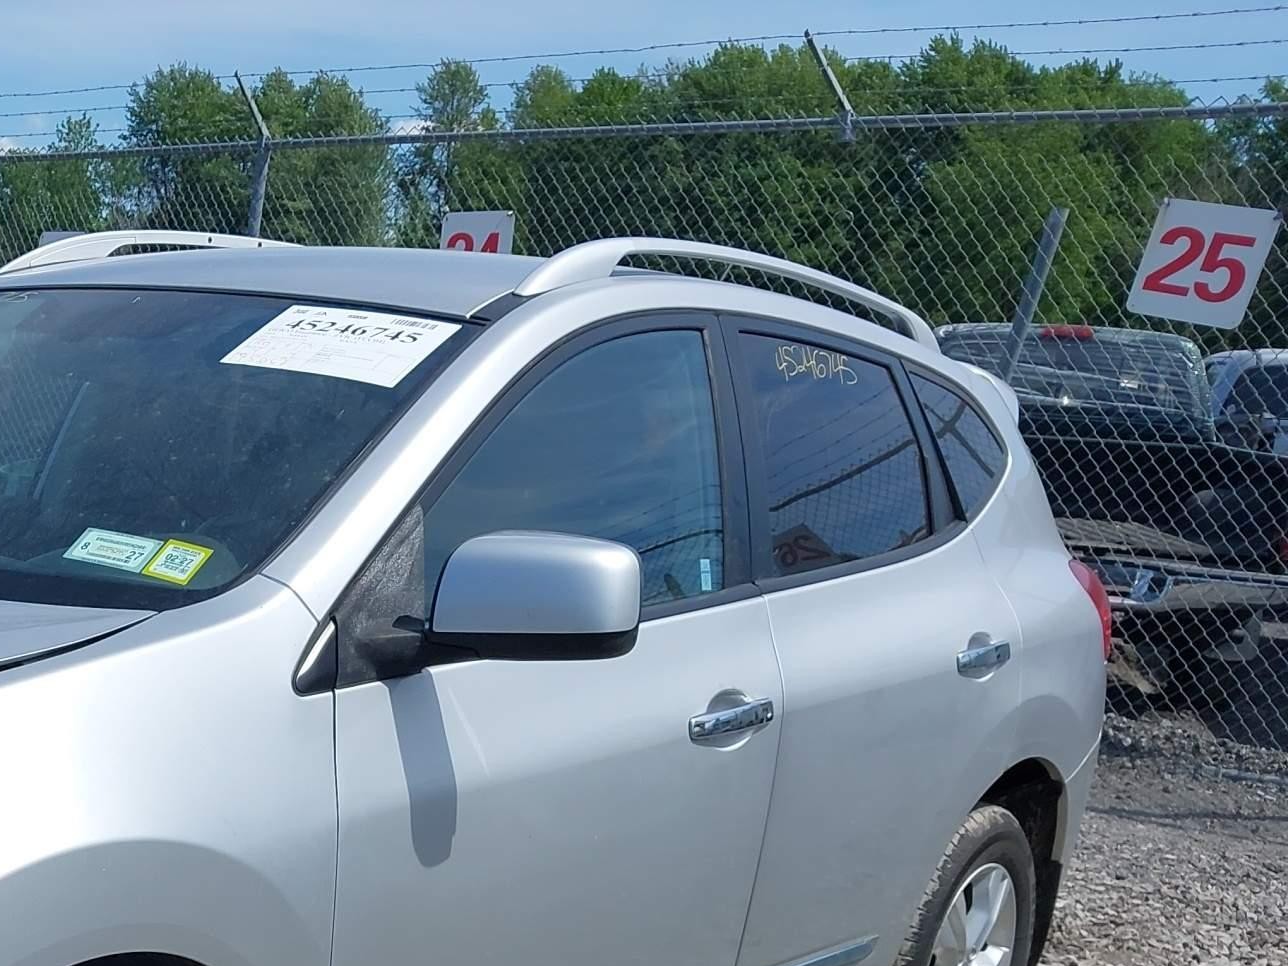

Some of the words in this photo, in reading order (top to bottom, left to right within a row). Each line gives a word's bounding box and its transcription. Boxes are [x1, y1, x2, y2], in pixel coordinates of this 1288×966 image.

[1142, 226, 1256, 303] 25
[285, 318, 425, 344] 45246745
[775, 345, 858, 385] 45246745
[125, 551, 145, 561] 27
